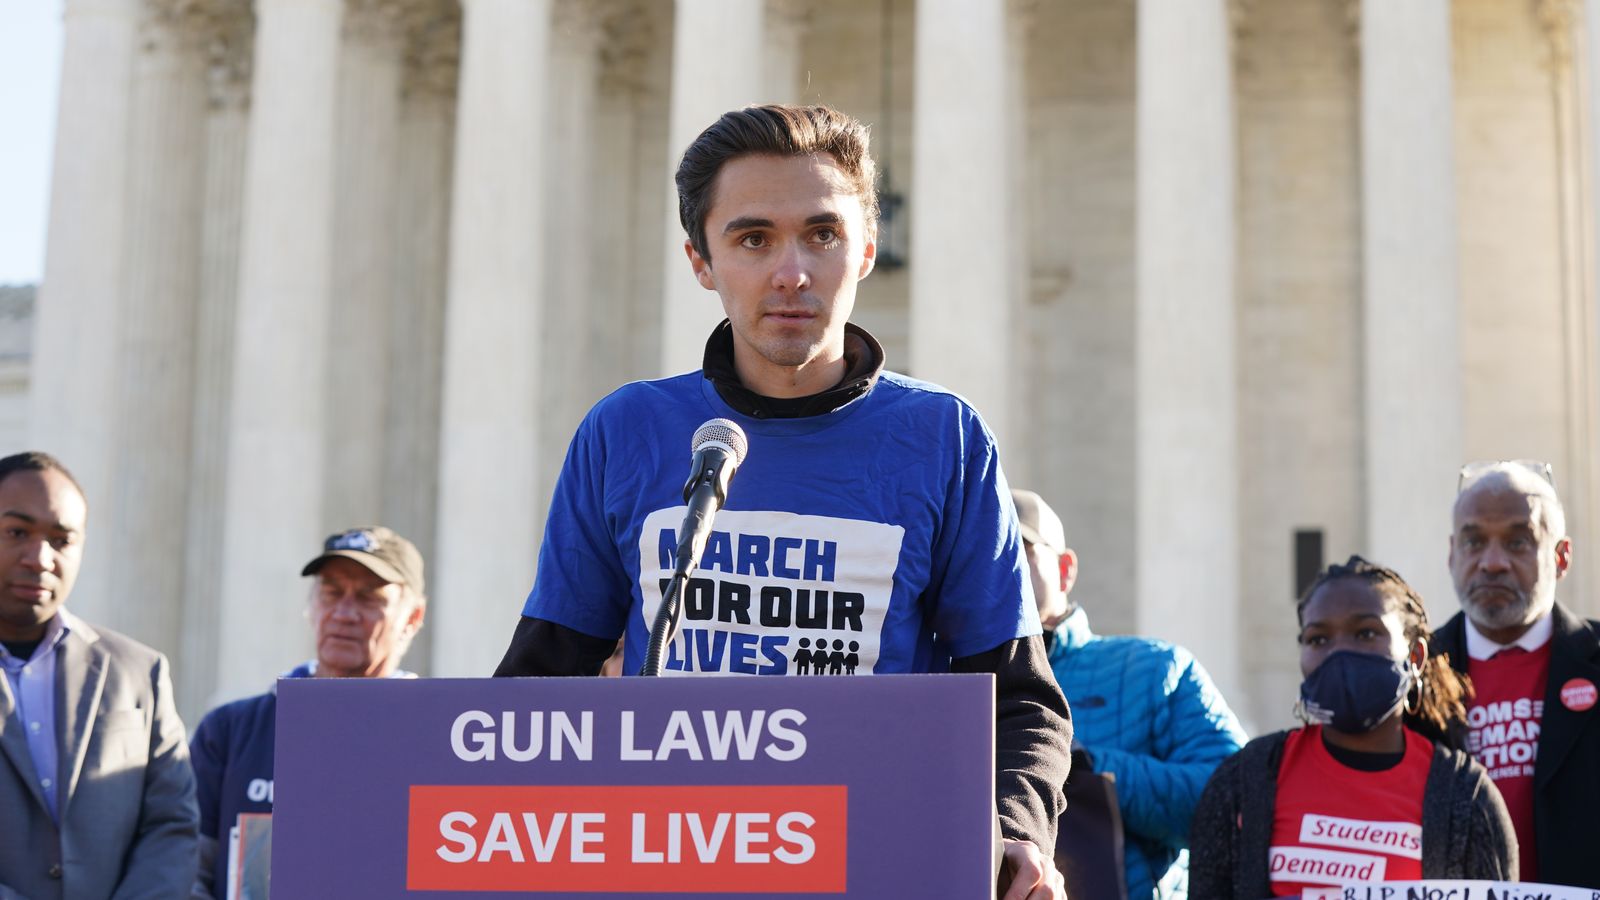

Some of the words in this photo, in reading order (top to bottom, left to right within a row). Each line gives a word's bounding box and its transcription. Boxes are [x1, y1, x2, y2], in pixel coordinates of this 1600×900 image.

[760, 586, 865, 632] OUR
[1468, 698, 1531, 728] OMS
[450, 710, 594, 762] GUN
[620, 709, 807, 761] LAWS
[436, 811, 606, 863] SAVE
[631, 811, 816, 865] LIVES
[1312, 819, 1421, 850] Students
[1270, 853, 1375, 880] Demand
